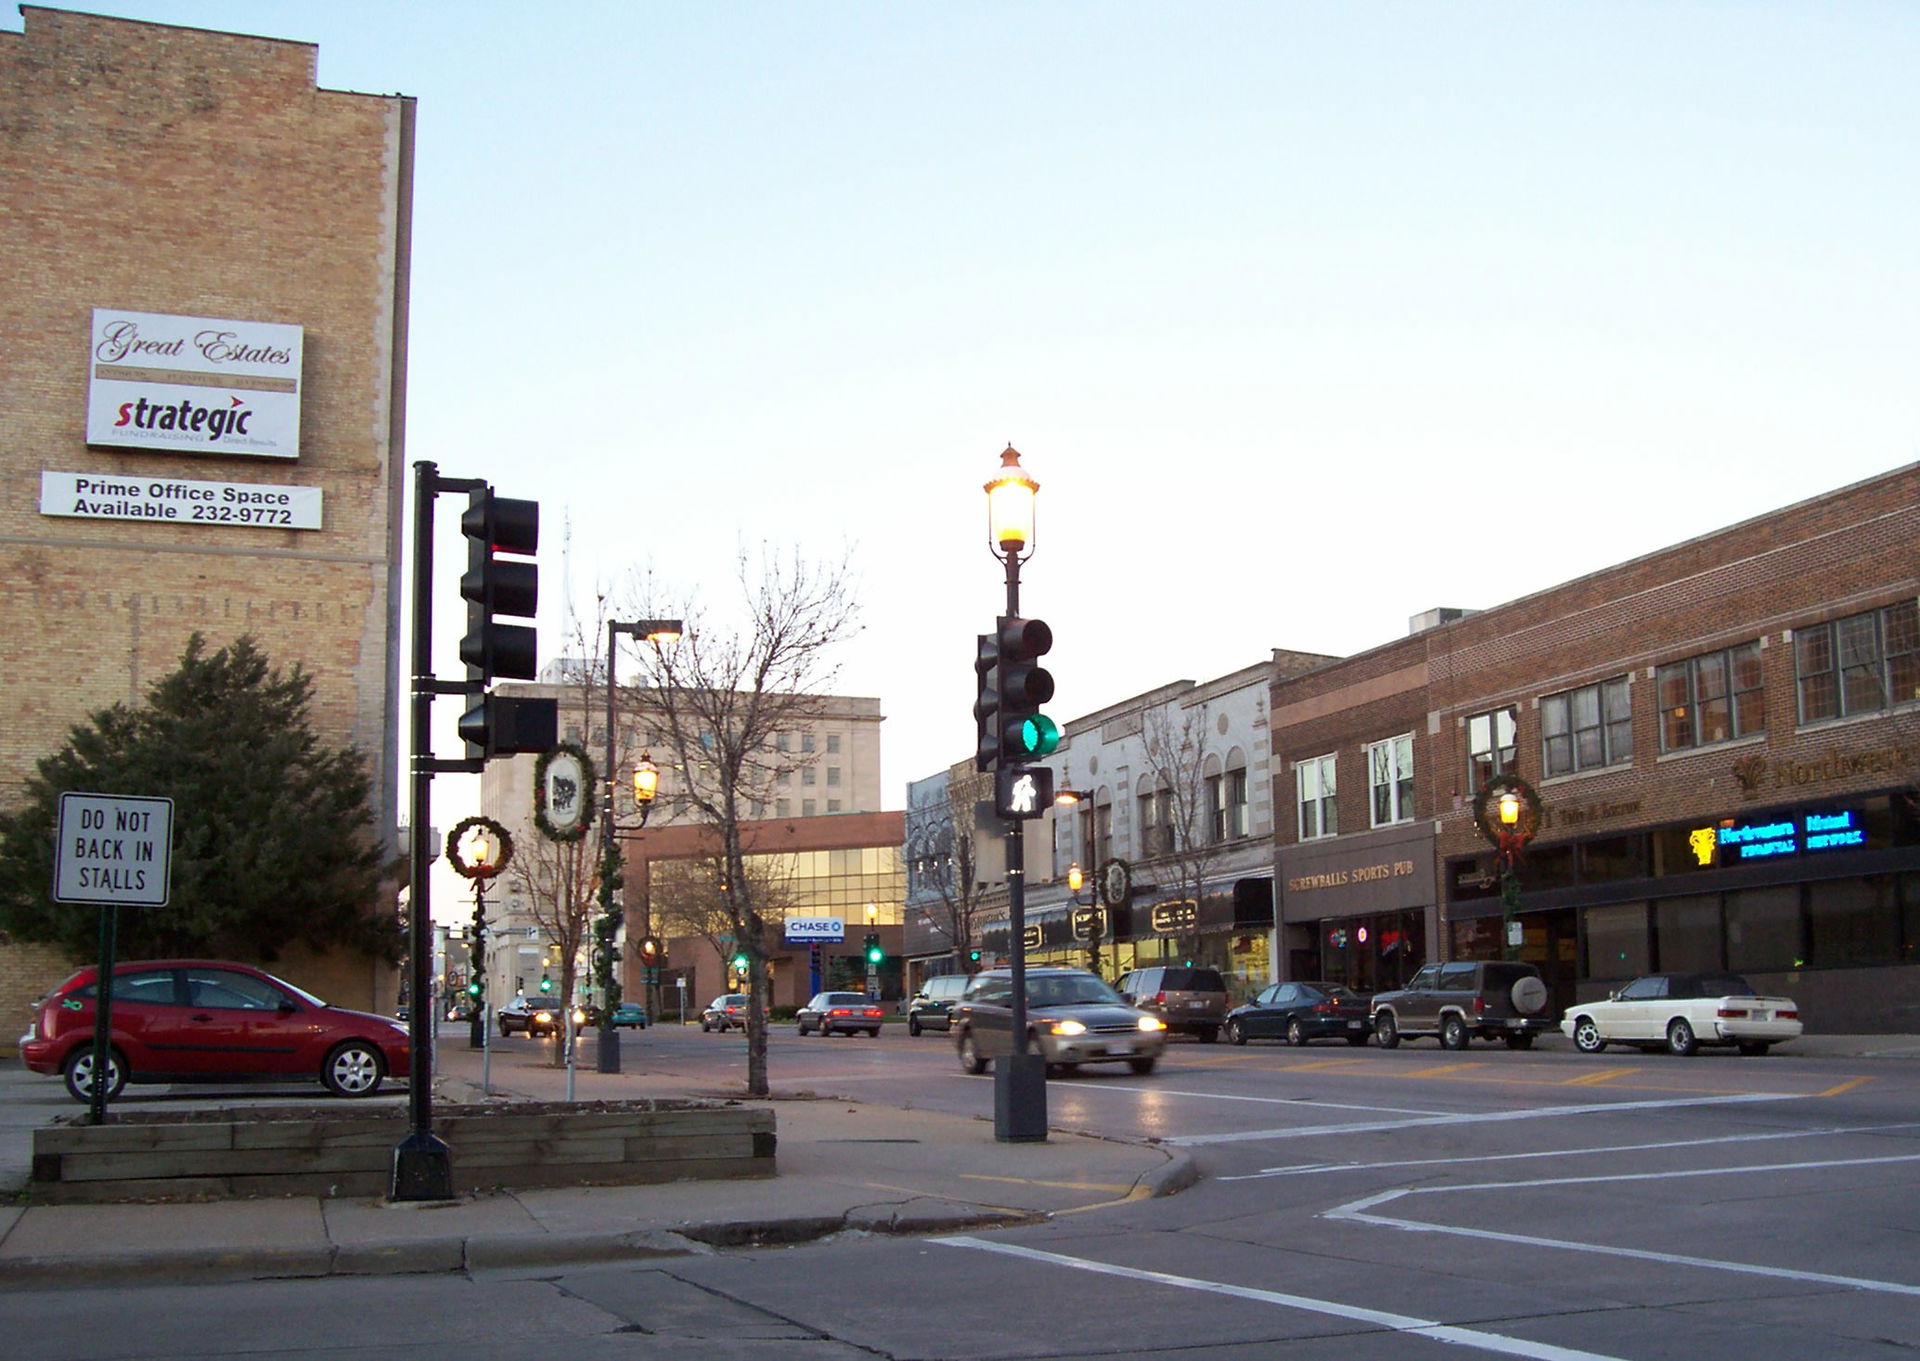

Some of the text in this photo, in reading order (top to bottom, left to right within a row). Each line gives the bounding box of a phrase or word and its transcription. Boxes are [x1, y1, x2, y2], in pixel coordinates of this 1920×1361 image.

[96, 320, 292, 365] Great Estates
[114, 397, 252, 441] strategic
[111, 428, 205, 444] FUNDRAISING
[76, 478, 291, 507] Prime Office Space
[73, 499, 292, 525] Available 232-9772
[81, 808, 151, 833] DO NOT
[75, 837, 153, 862] BACK IN
[79, 867, 146, 890] STALLS
[1288, 860, 1414, 892] SCREWBALLS SPORTS PUB
[791, 922, 830, 932] CHASE
